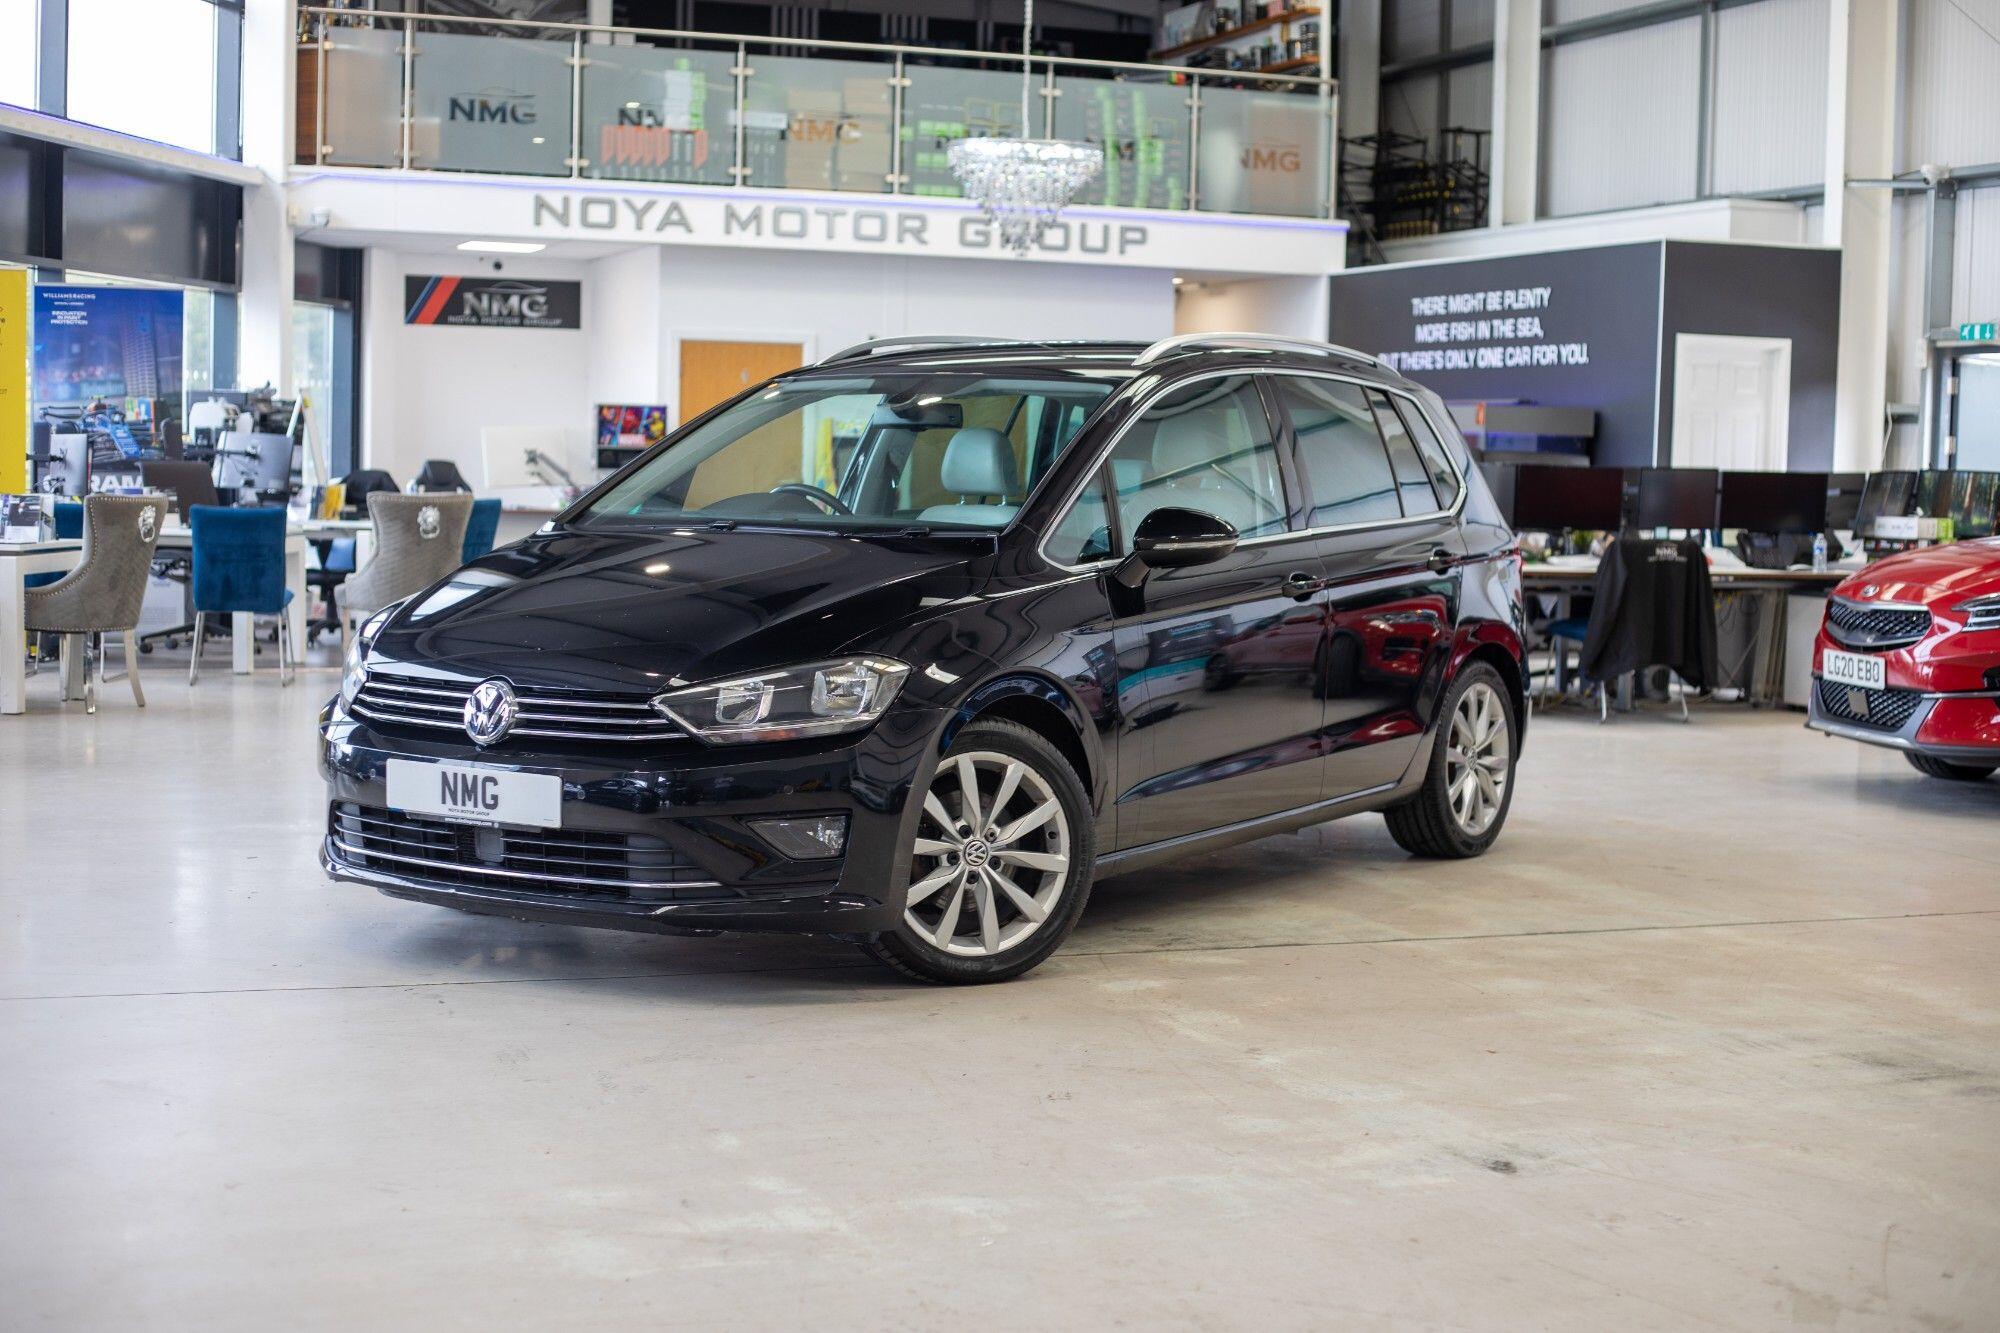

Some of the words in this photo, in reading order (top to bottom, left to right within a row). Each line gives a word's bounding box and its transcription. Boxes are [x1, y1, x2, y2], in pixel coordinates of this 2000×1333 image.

[448, 97, 536, 124] NMG
[534, 194, 693, 234] NOYA
[724, 203, 928, 245] MOTOR
[959, 215, 1148, 256] GOUP
[463, 292, 548, 318] NMG
[1411, 297, 1447, 317] THERE
[1450, 293, 1486, 315] MIGHT
[1486, 290, 1502, 312] BE
[1503, 286, 1551, 311] PLENTY
[1415, 323, 1449, 344] MORE
[1450, 321, 1476, 341] FISH
[1477, 320, 1490, 340] IN
[1492, 318, 1515, 340] THE
[1516, 316, 1544, 340] SEA,
[1400, 350, 1444, 371] THERE'S
[1444, 349, 1477, 370] ONLY
[1477, 347, 1503, 369] ONE
[1505, 345, 1531, 367] CAR
[1532, 344, 1558, 366] FOR
[1560, 343, 1589, 365] YOU.
[1827, 654, 1854, 679] LG20
[1857, 659, 1880, 683] EBO
[441, 771, 499, 811] NMG
